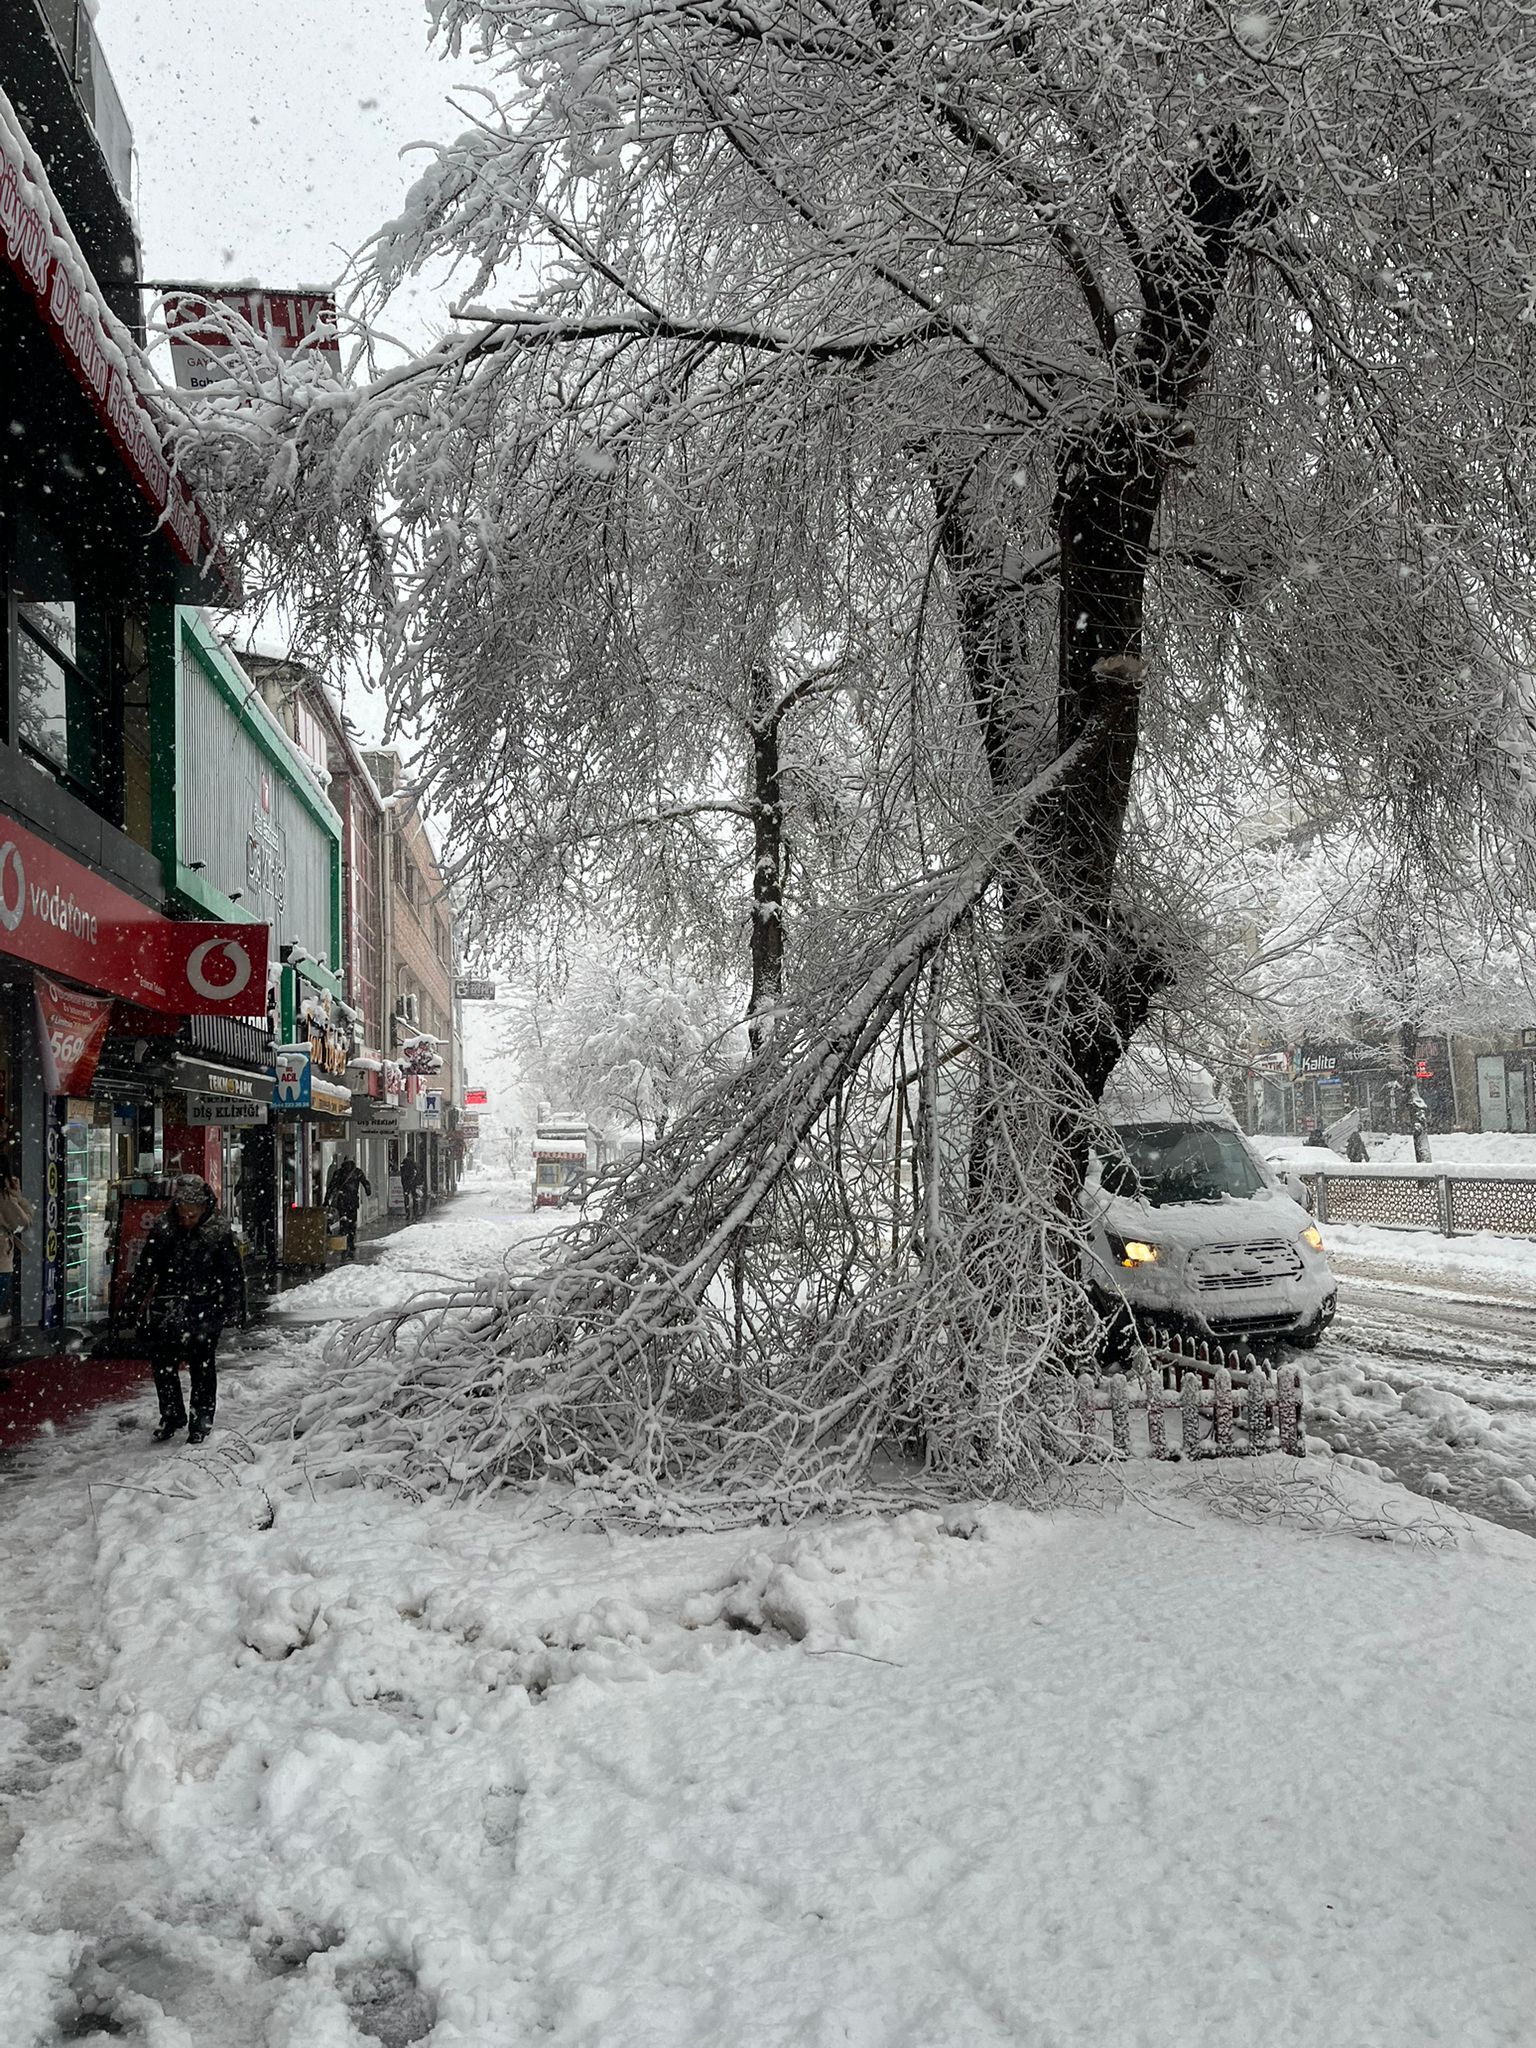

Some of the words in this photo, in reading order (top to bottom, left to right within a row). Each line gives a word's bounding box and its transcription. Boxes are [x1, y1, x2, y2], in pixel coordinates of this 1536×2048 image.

[0, 146, 50, 295] üyük
[50, 262, 108, 401] Dürüm
[107, 366, 169, 506] Restoran
[177, 293, 323, 338] STILIK
[30, 882, 98, 945] vodafone
[1302, 1054, 1336, 1072] Kalite
[193, 1105, 212, 1120] DİŞ
[216, 1103, 260, 1118] KLİNİĞİ
